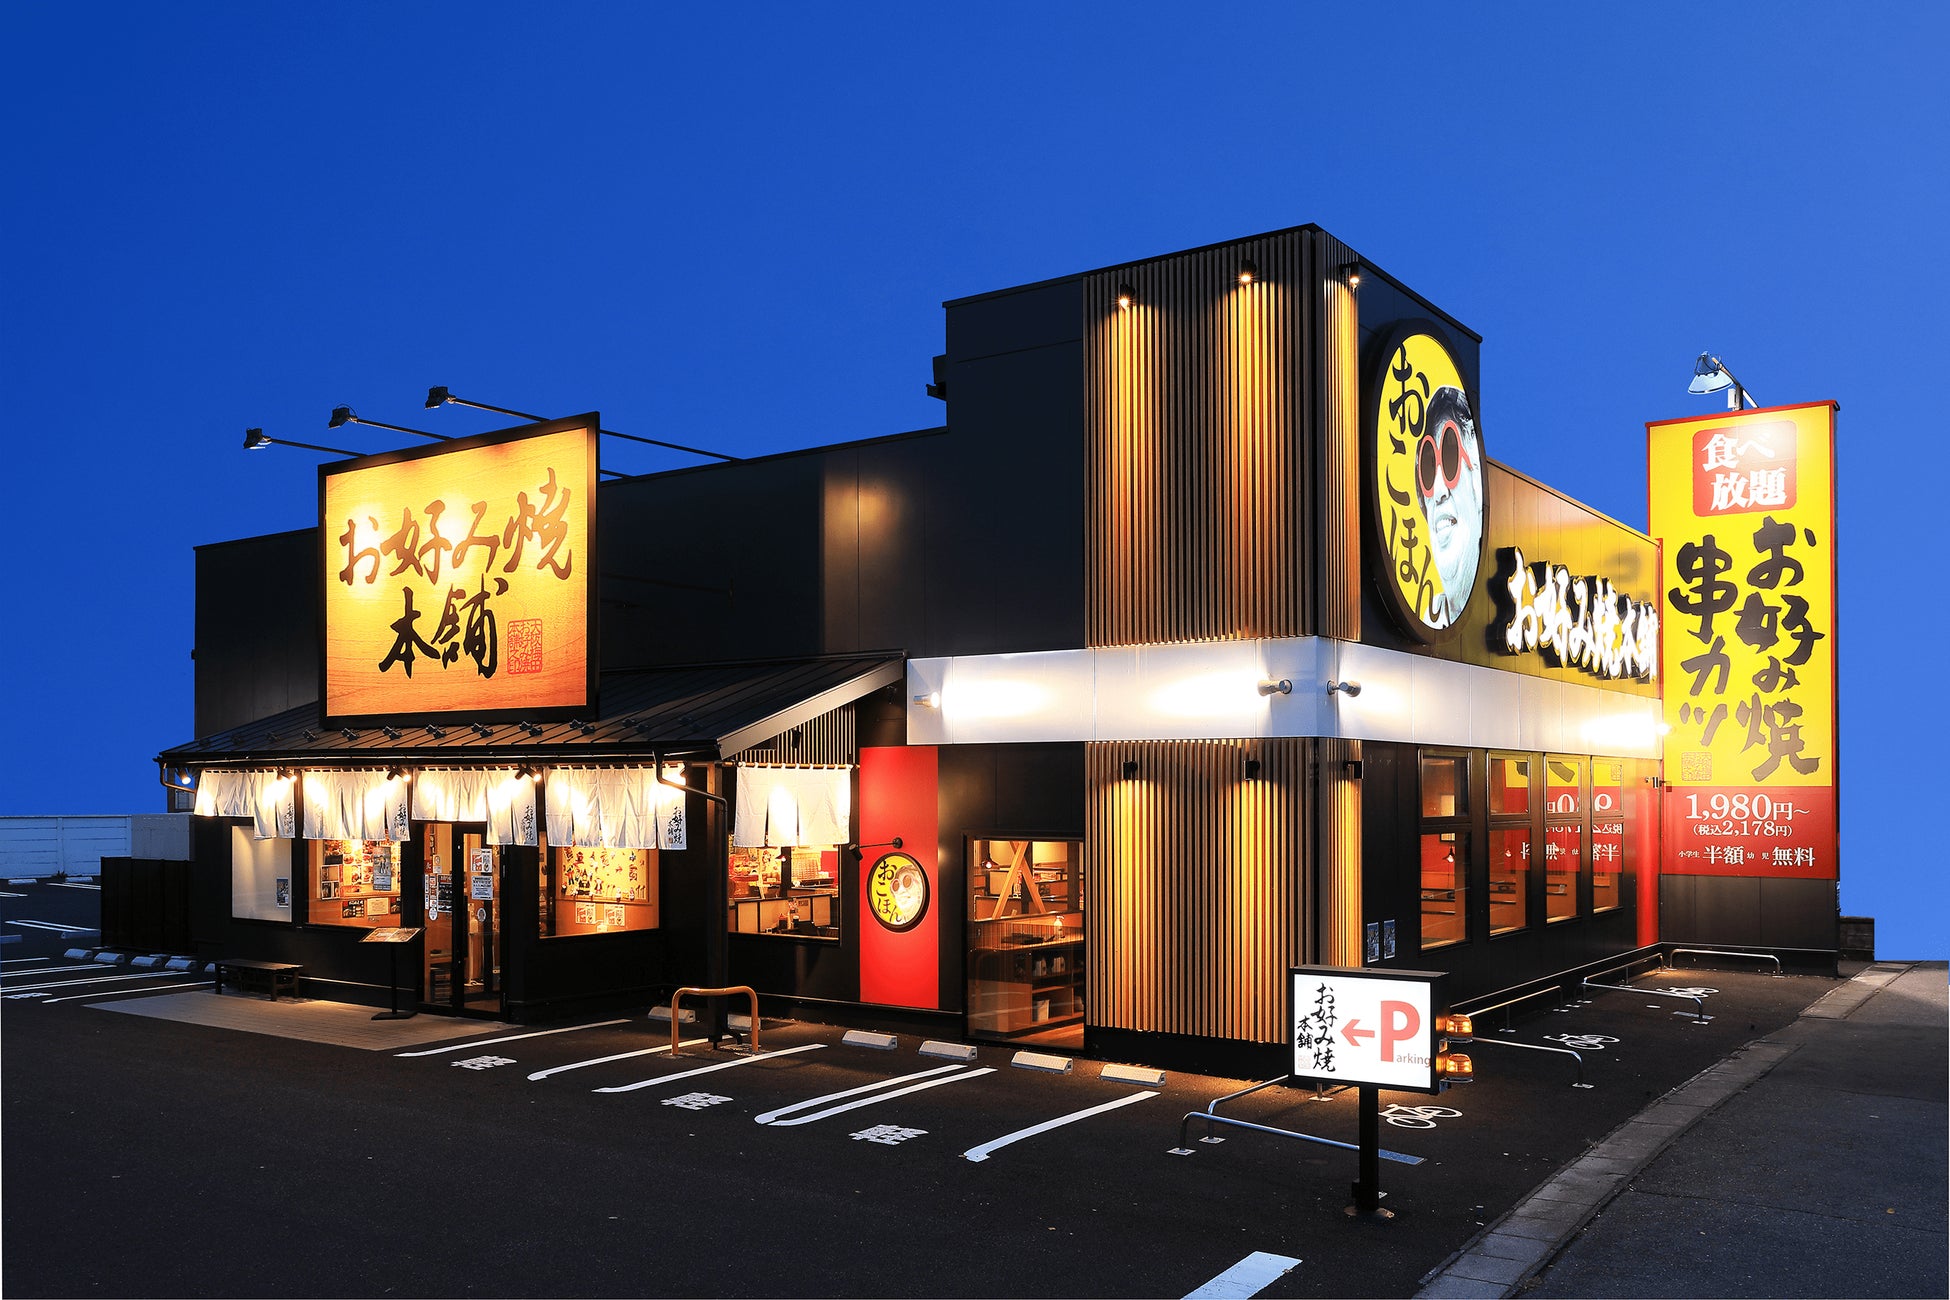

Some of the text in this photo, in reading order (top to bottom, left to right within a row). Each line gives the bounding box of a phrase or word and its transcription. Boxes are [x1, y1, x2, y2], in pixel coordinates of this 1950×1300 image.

[1386, 343, 1449, 623] おこほん
[1702, 433, 1774, 472] 食べ
[1710, 467, 1787, 512] 放題
[339, 467, 572, 586] お好み焼
[378, 573, 509, 679] 本舗
[1668, 534, 1738, 748] 串カツ
[1734, 516, 1825, 783] お好み焼
[672, 806, 683, 844] お好み焼
[1679, 850, 1700, 858] 小学生
[1703, 845, 1745, 865] 半額
[1772, 846, 1815, 867] 無料
[876, 860, 902, 922] おこほん
[1297, 1015, 1313, 1049] 本舗
[1310, 982, 1338, 1072] お好み焼
